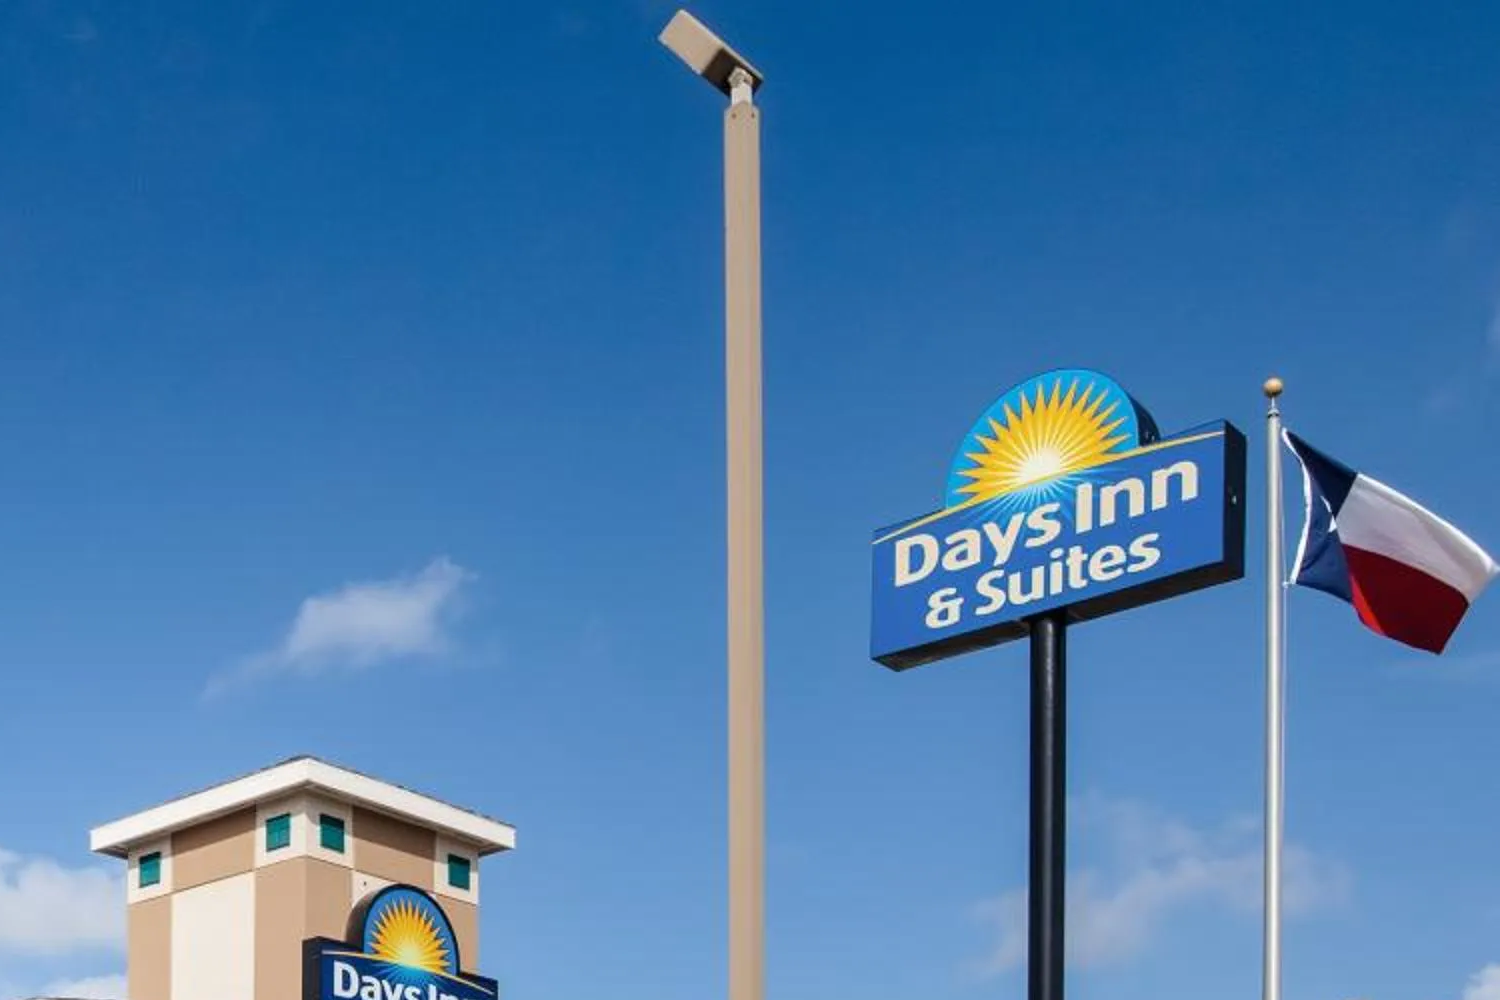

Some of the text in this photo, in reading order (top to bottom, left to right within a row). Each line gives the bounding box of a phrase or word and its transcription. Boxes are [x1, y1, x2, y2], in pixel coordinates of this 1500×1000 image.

[894, 460, 1199, 587] Days Inn
[925, 532, 1162, 629] & Suites
